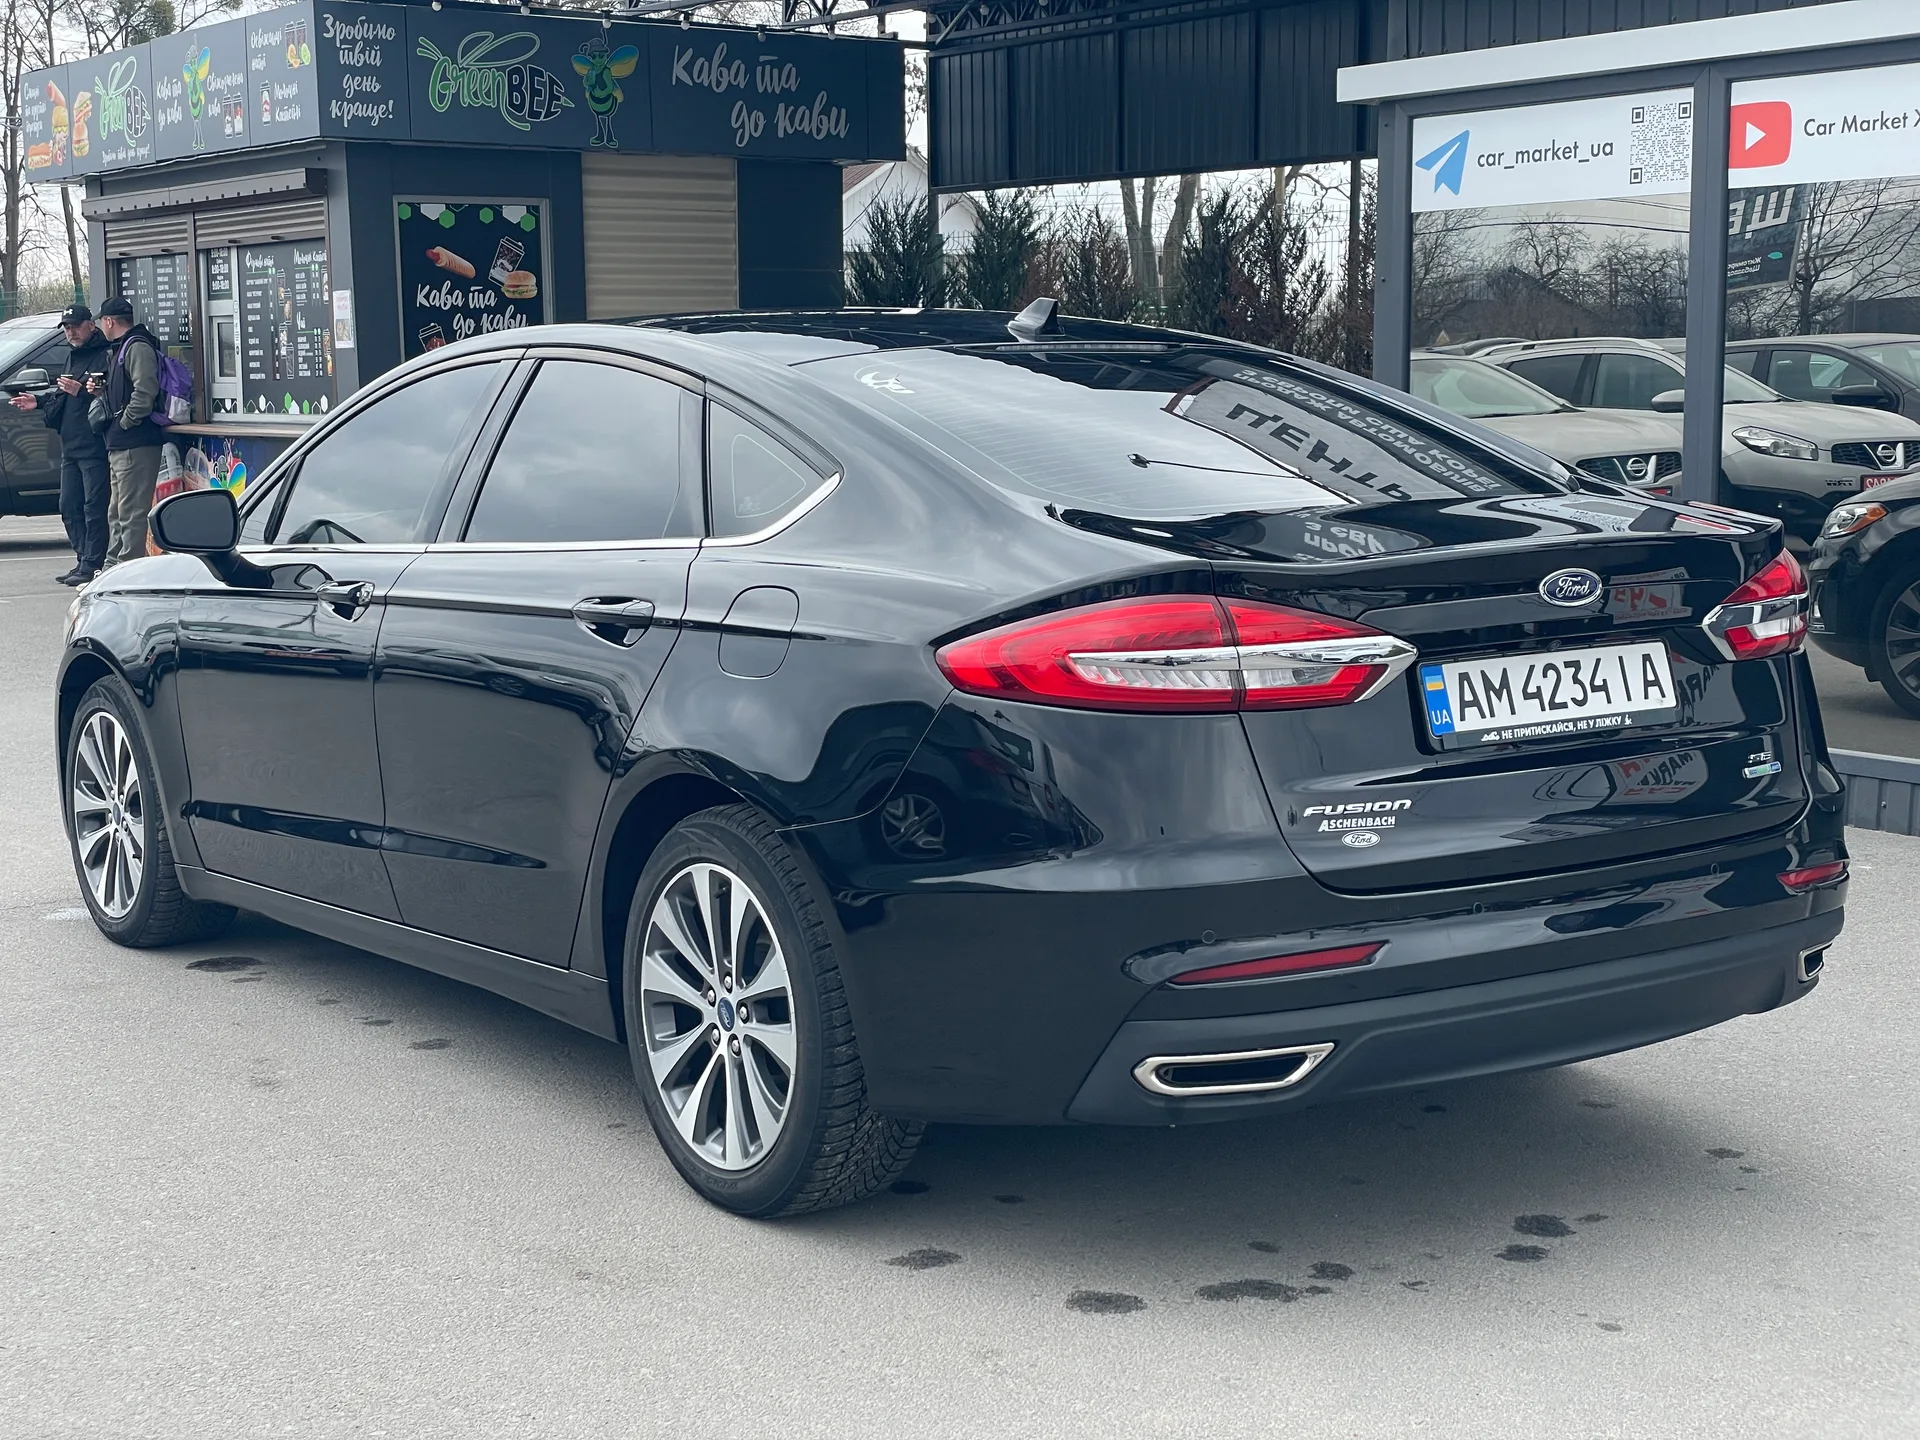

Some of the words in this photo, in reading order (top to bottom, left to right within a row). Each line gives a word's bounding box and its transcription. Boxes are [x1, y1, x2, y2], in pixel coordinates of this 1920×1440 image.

[323, 13, 396, 47] Зробимо
[339, 41, 382, 67] твій
[672, 42, 750, 93] Кава
[756, 55, 801, 94] та
[342, 73, 381, 98] день
[330, 99, 394, 127] краще!
[731, 100, 766, 147] до
[774, 90, 849, 140] кави
[1804, 118, 1836, 136] Car
[1841, 110, 1908, 134] Market
[1477, 139, 1614, 169] car_market_ua
[416, 280, 465, 310] Кава
[468, 286, 498, 309] та
[453, 313, 476, 340] до
[480, 304, 529, 334] кави
[1556, 577, 1590, 598] Ford
[1458, 667, 1516, 721] AM
[1521, 657, 1612, 712] 4234
[1618, 653, 1666, 702] IA
[1431, 709, 1452, 726] UA
[1501, 730, 1513, 740] НЕ
[1514, 722, 1577, 739] ПРИТИСКАЙСЯ,
[1577, 720, 1588, 730] НЕ
[1589, 719, 1595, 729] У
[1303, 799, 1412, 817] FUSION
[1318, 815, 1396, 832] ASCHENBACH
[1350, 834, 1373, 844] Ford
